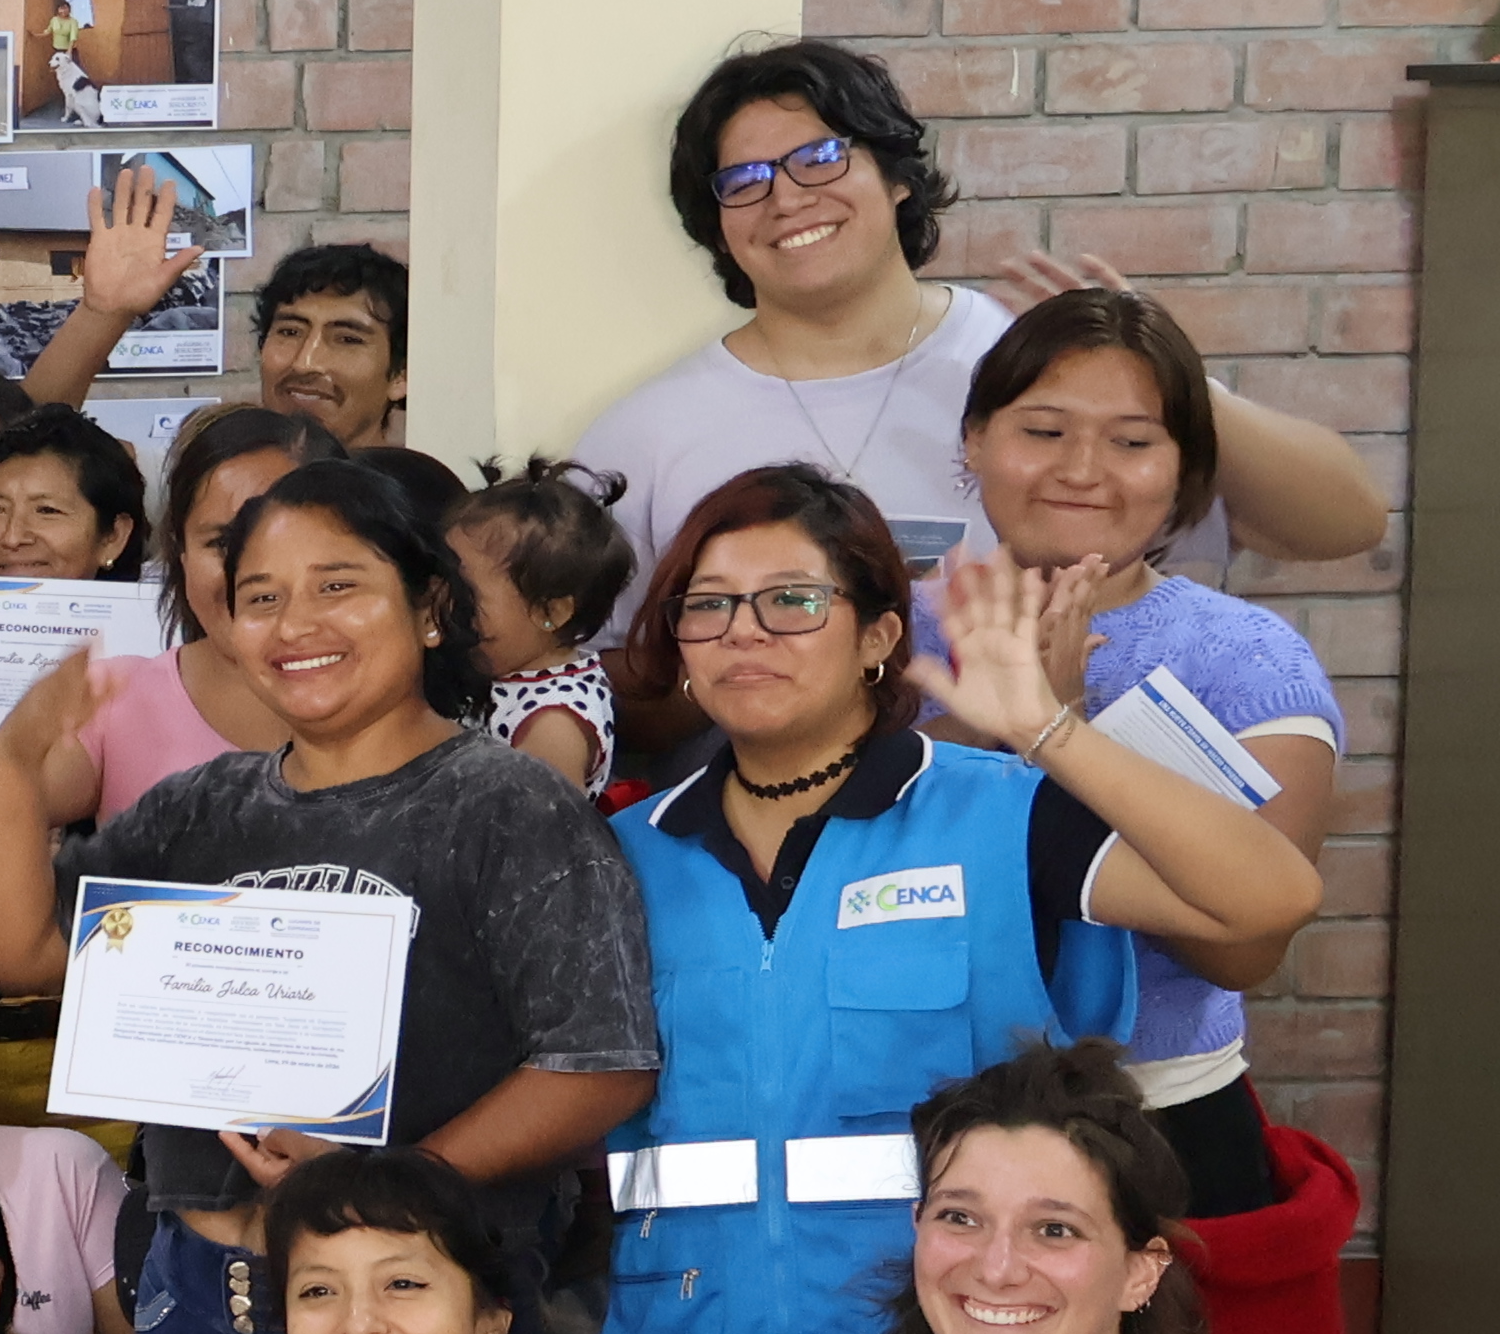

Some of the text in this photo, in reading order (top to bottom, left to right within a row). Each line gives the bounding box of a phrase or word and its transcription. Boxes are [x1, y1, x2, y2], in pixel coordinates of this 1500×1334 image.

[131, 344, 164, 357] CENCA
[875, 883, 957, 913] CENCA
[173, 940, 305, 960] RECONOCIMIENTO
[159, 974, 316, 1001] Familia Julca Uriarte
